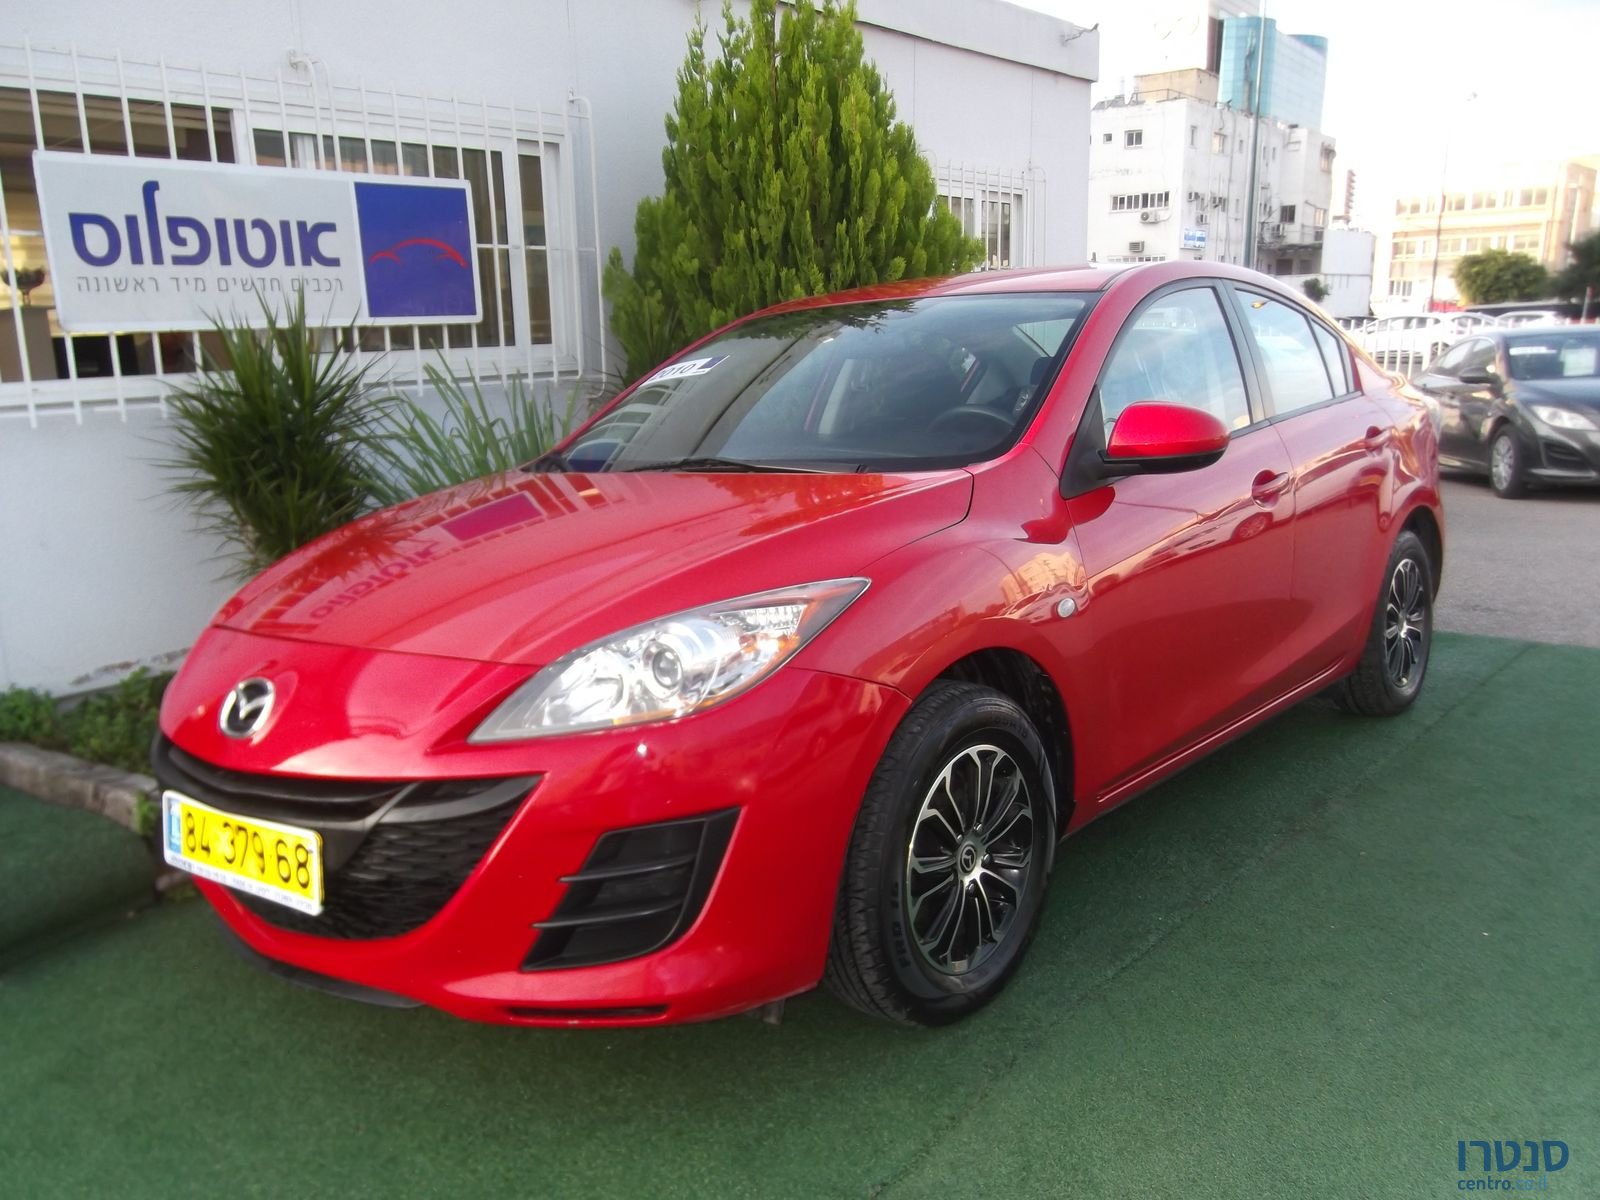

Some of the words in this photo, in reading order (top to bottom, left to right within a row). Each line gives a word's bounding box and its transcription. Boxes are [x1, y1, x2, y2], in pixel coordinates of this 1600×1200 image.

[68, 180, 341, 268] אוטופלוס
[77, 275, 160, 292] ראשונה
[170, 276, 206, 292] מיד
[217, 276, 281, 292] חדשים
[291, 277, 343, 292] רכבים
[186, 812, 211, 856] 84
[223, 822, 265, 875] 379
[275, 839, 311, 889] 68
